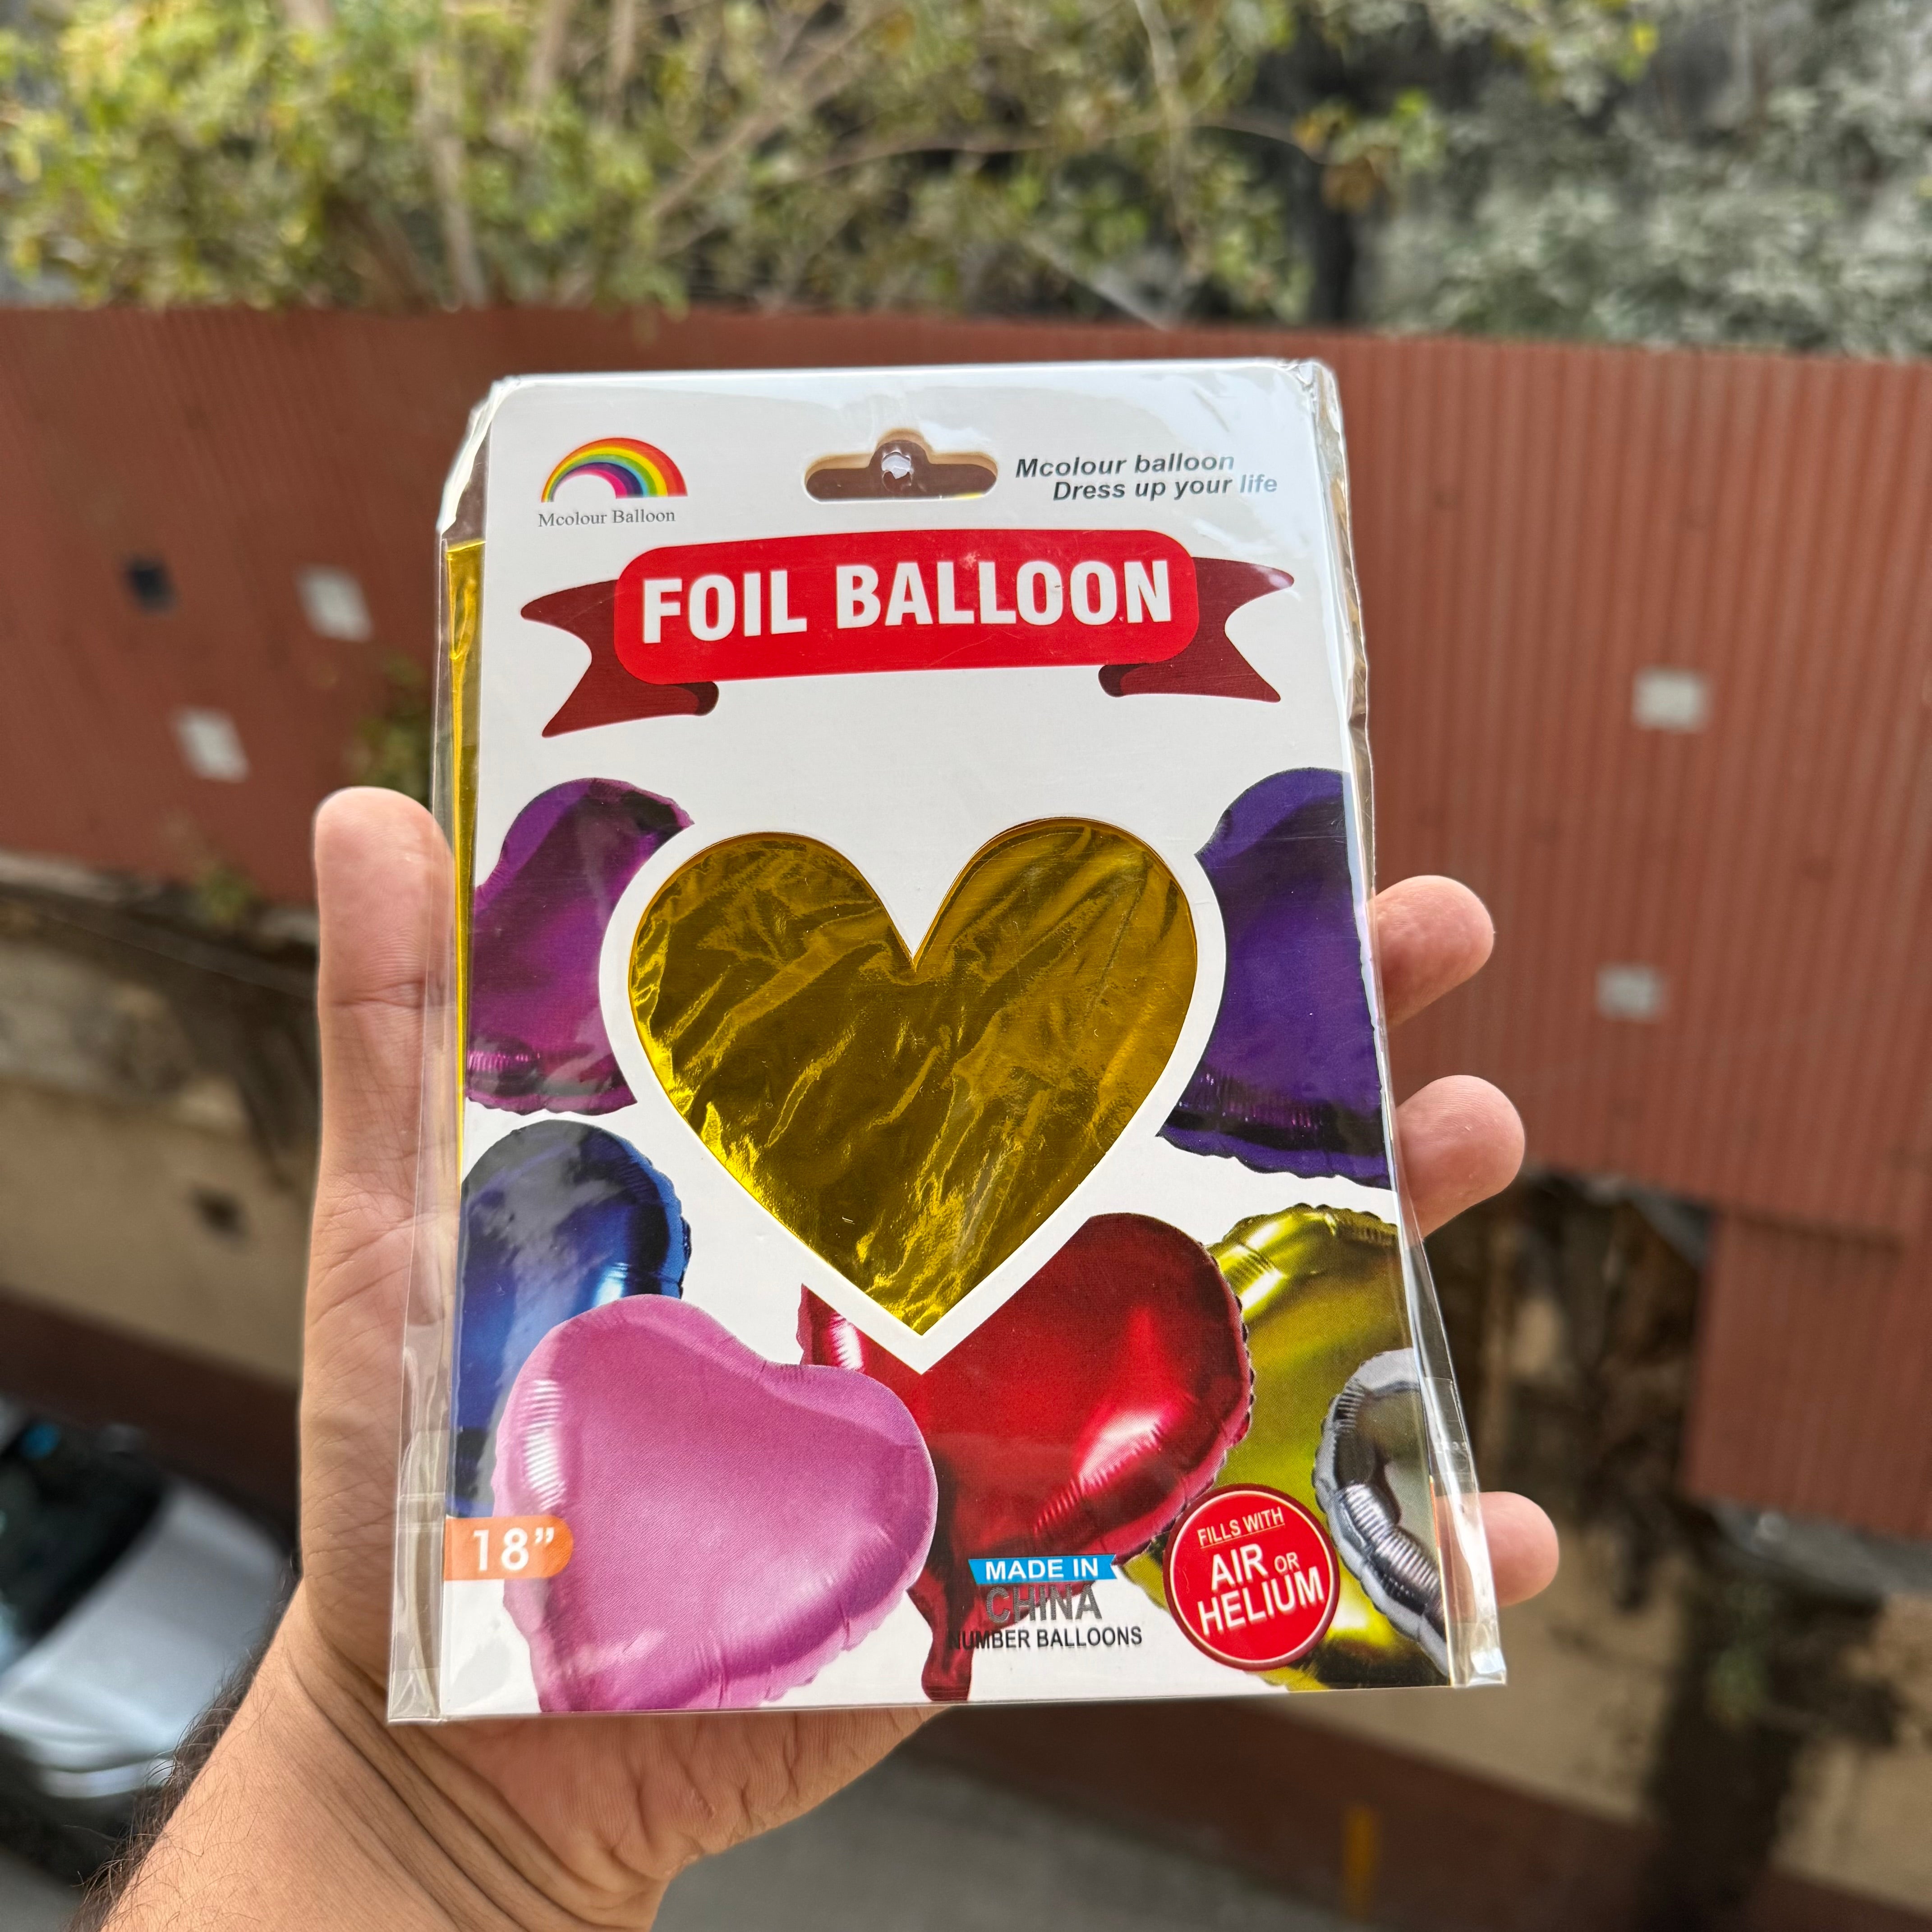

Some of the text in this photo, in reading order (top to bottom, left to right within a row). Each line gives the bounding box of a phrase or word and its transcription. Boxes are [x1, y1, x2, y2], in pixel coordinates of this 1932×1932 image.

[1016, 453, 1234, 478] Mcolour balloon
[1053, 474, 1278, 501] Dress up your life
[538, 509, 676, 527] Mcolour Balloon
[642, 560, 1172, 644] FOIL BALLOON
[1196, 1506, 1284, 1547] FILLS WITH
[985, 1558, 1098, 1580] MADE IN
[1211, 1543, 1300, 1592] AIR OR
[985, 1584, 1102, 1624] CHINA
[1197, 1565, 1324, 1637] HELIUM
[1037, 1626, 1142, 1649] BALLOONS
